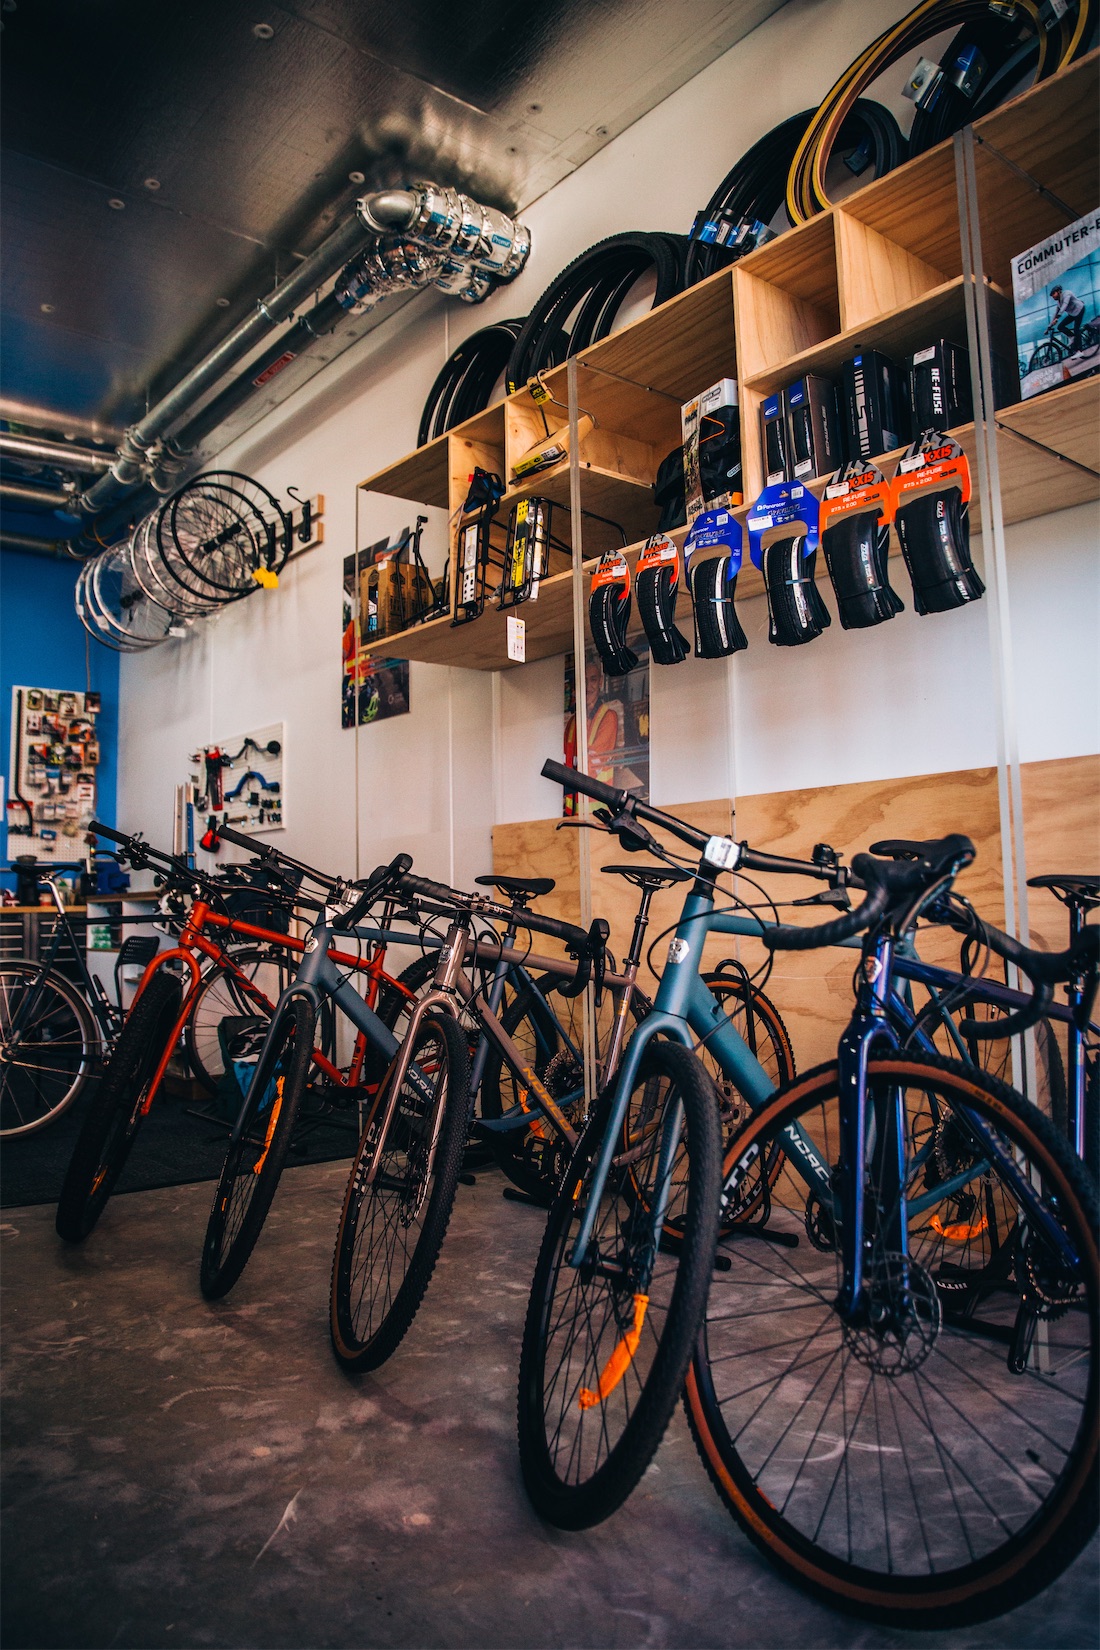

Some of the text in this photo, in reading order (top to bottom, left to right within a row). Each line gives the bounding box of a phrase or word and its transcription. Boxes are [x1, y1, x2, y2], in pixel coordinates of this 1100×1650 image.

[931, 368, 943, 415] RE-FUSE
[924, 445, 953, 464] XXIS
[848, 471, 875, 489] XXIS
[916, 465, 943, 479] RE-FUSE
[842, 491, 867, 503] RE-FUSE
[521, 1066, 572, 1132] NORCO
[783, 1125, 832, 1190] NORC
